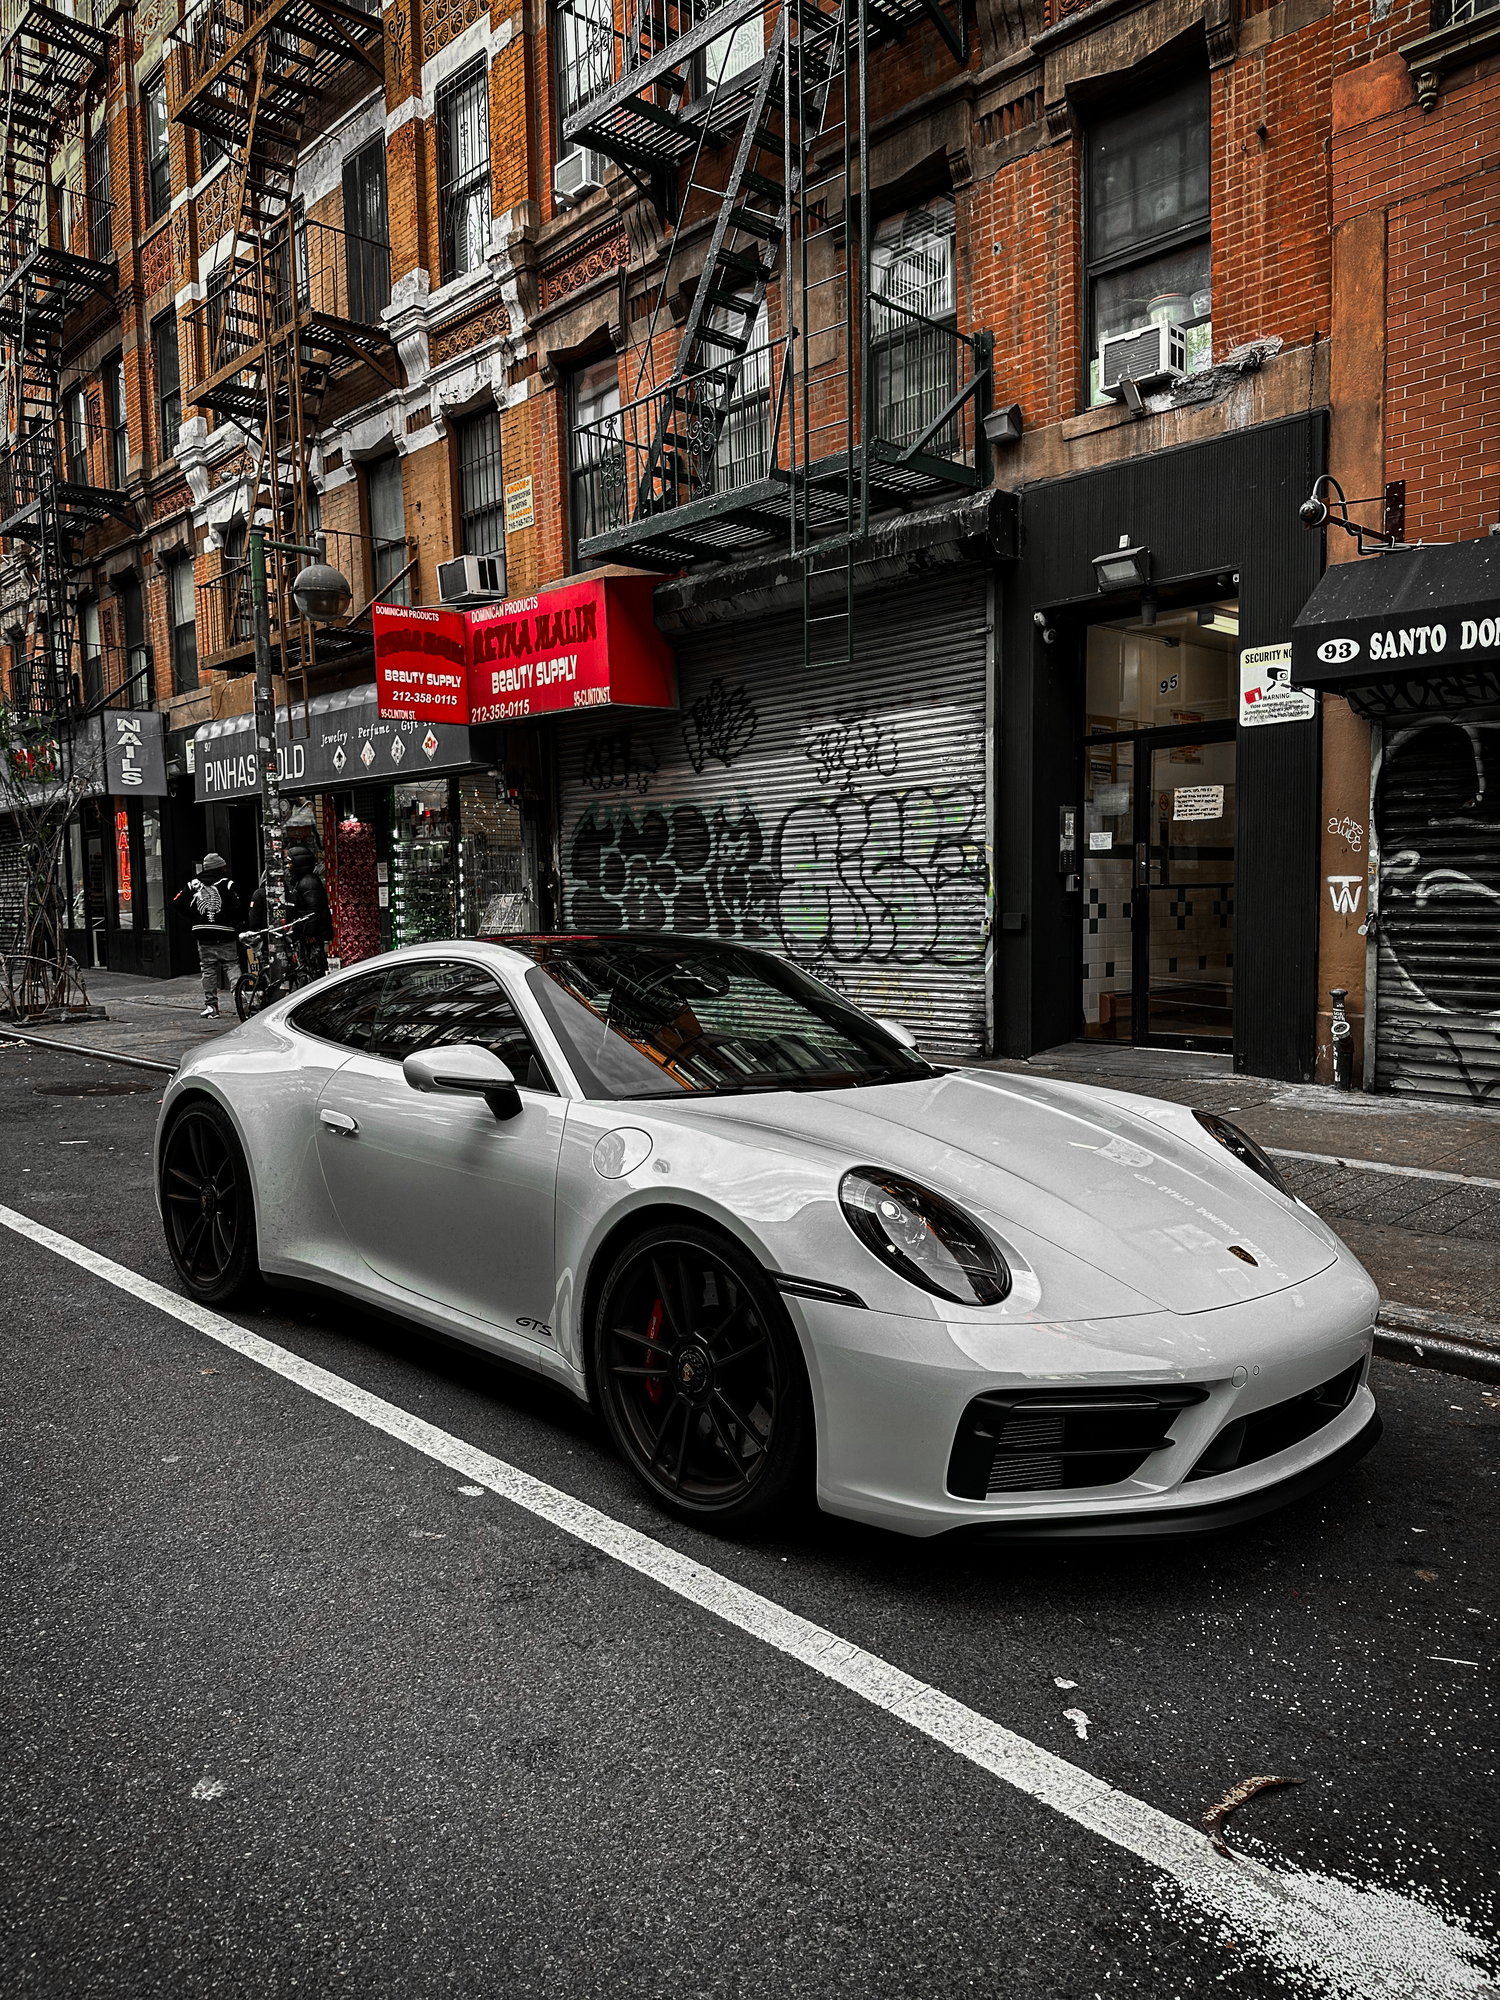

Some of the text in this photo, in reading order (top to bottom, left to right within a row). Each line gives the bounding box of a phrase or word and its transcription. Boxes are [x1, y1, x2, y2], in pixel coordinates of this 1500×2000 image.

[375, 605, 439, 622] DOMINICAN PRODUCTS
[471, 596, 538, 623] DOMINICAN PRODUCTS
[1324, 642, 1352, 660] 93
[1369, 624, 1447, 661] SANTO
[1245, 649, 1282, 664] SECURITY
[426, 673, 462, 688] SUPPLY
[536, 654, 577, 686] SUPPLY
[1160, 674, 1178, 693] 95
[471, 699, 530, 723] 212-358-0115
[204, 742, 212, 752] 97
[320, 729, 348, 747] Jewelry
[358, 723, 390, 740] Perfume
[116, 718, 143, 786] NAILS
[205, 754, 257, 793] PINHAS
[115, 811, 132, 901] NAILS
[515, 1317, 552, 1337] GTS
